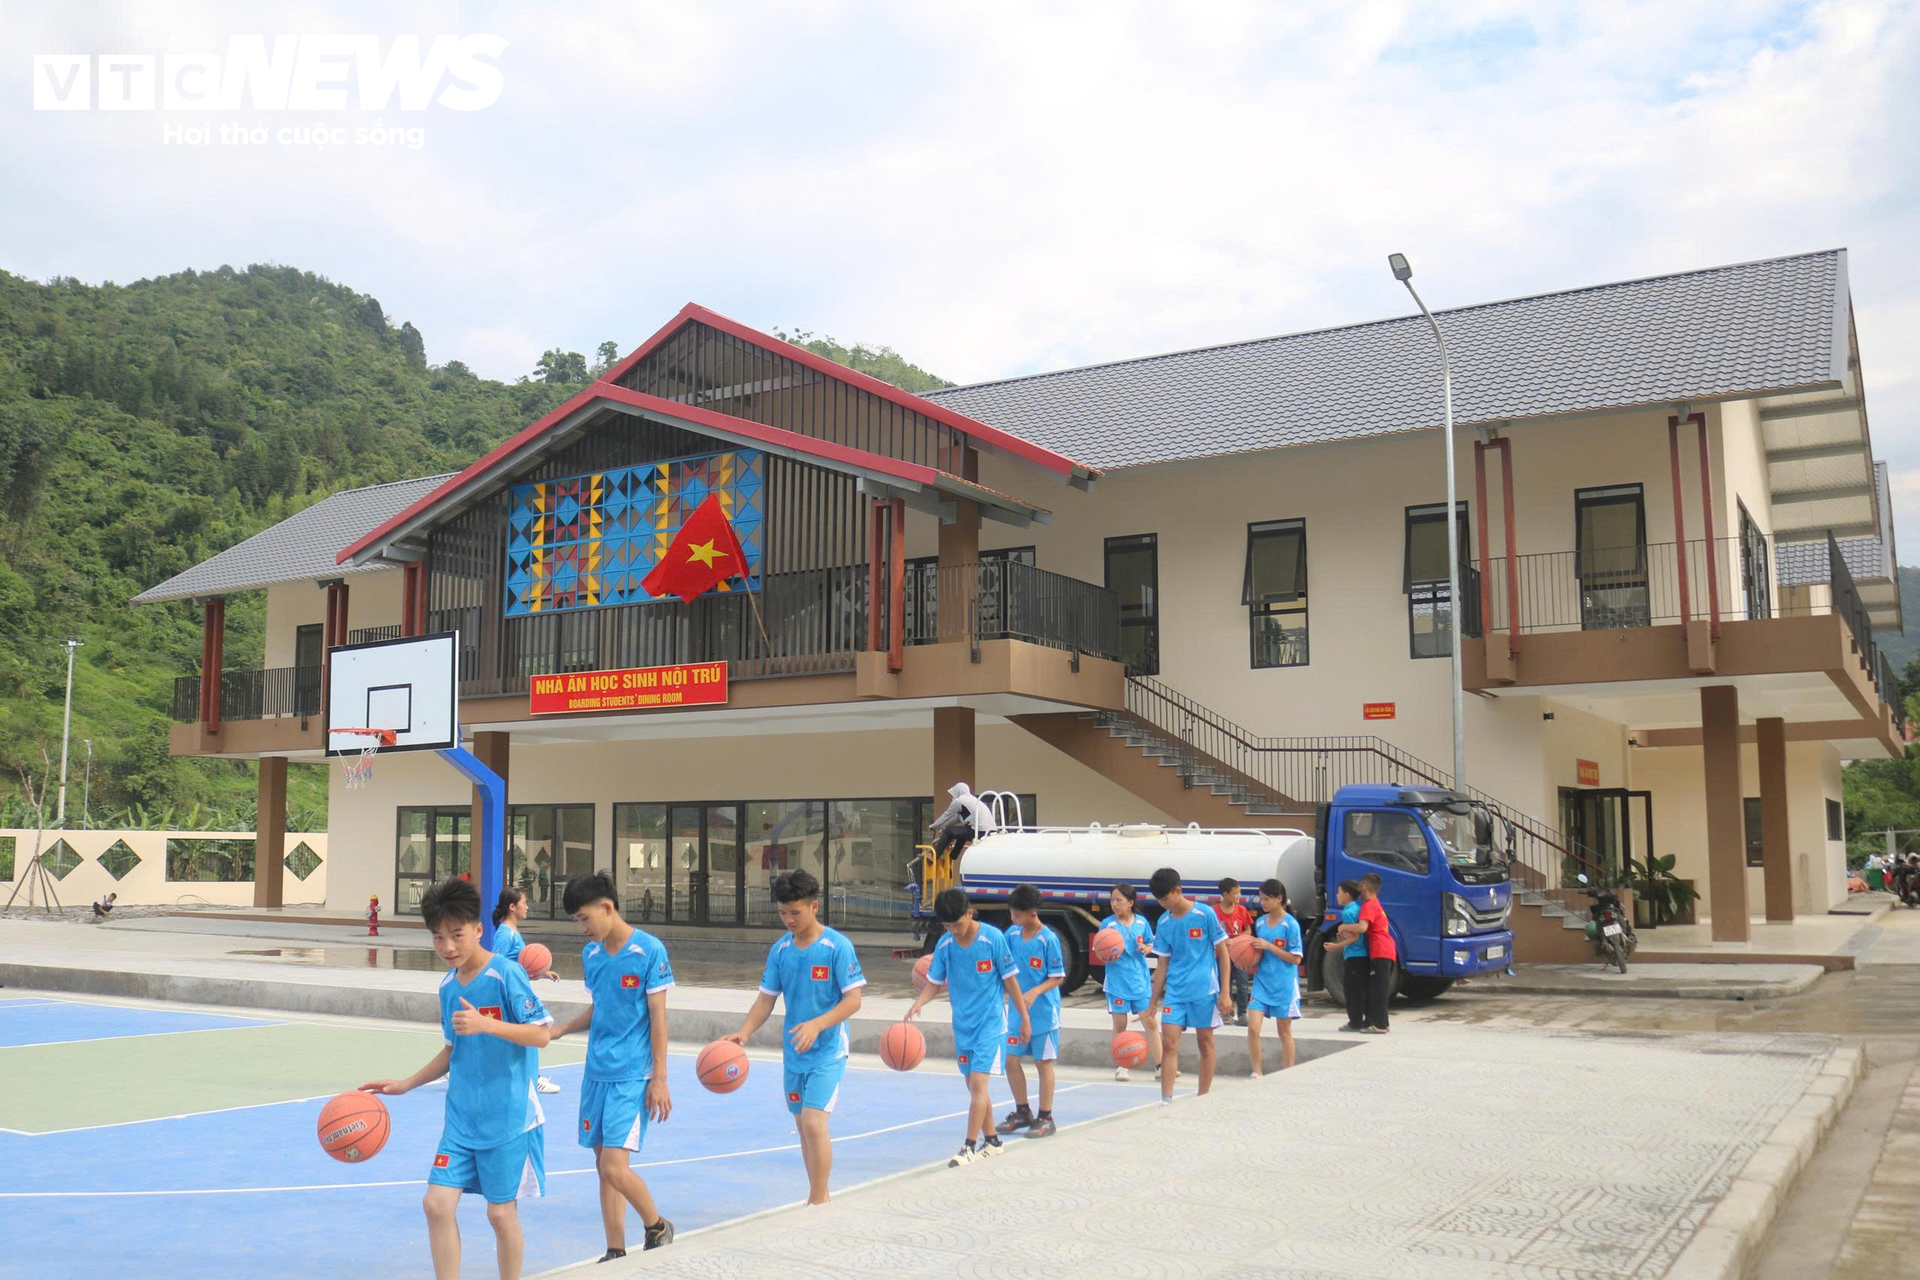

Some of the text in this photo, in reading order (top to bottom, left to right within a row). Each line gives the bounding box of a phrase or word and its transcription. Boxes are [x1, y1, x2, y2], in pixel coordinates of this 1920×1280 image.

[536, 664, 721, 694] NHÀ ĂN HỌC SINH NỘI TRÚ
[569, 697, 600, 708] BOARDING
[638, 693, 660, 704] DINING
[662, 692, 682, 703] ROOM
